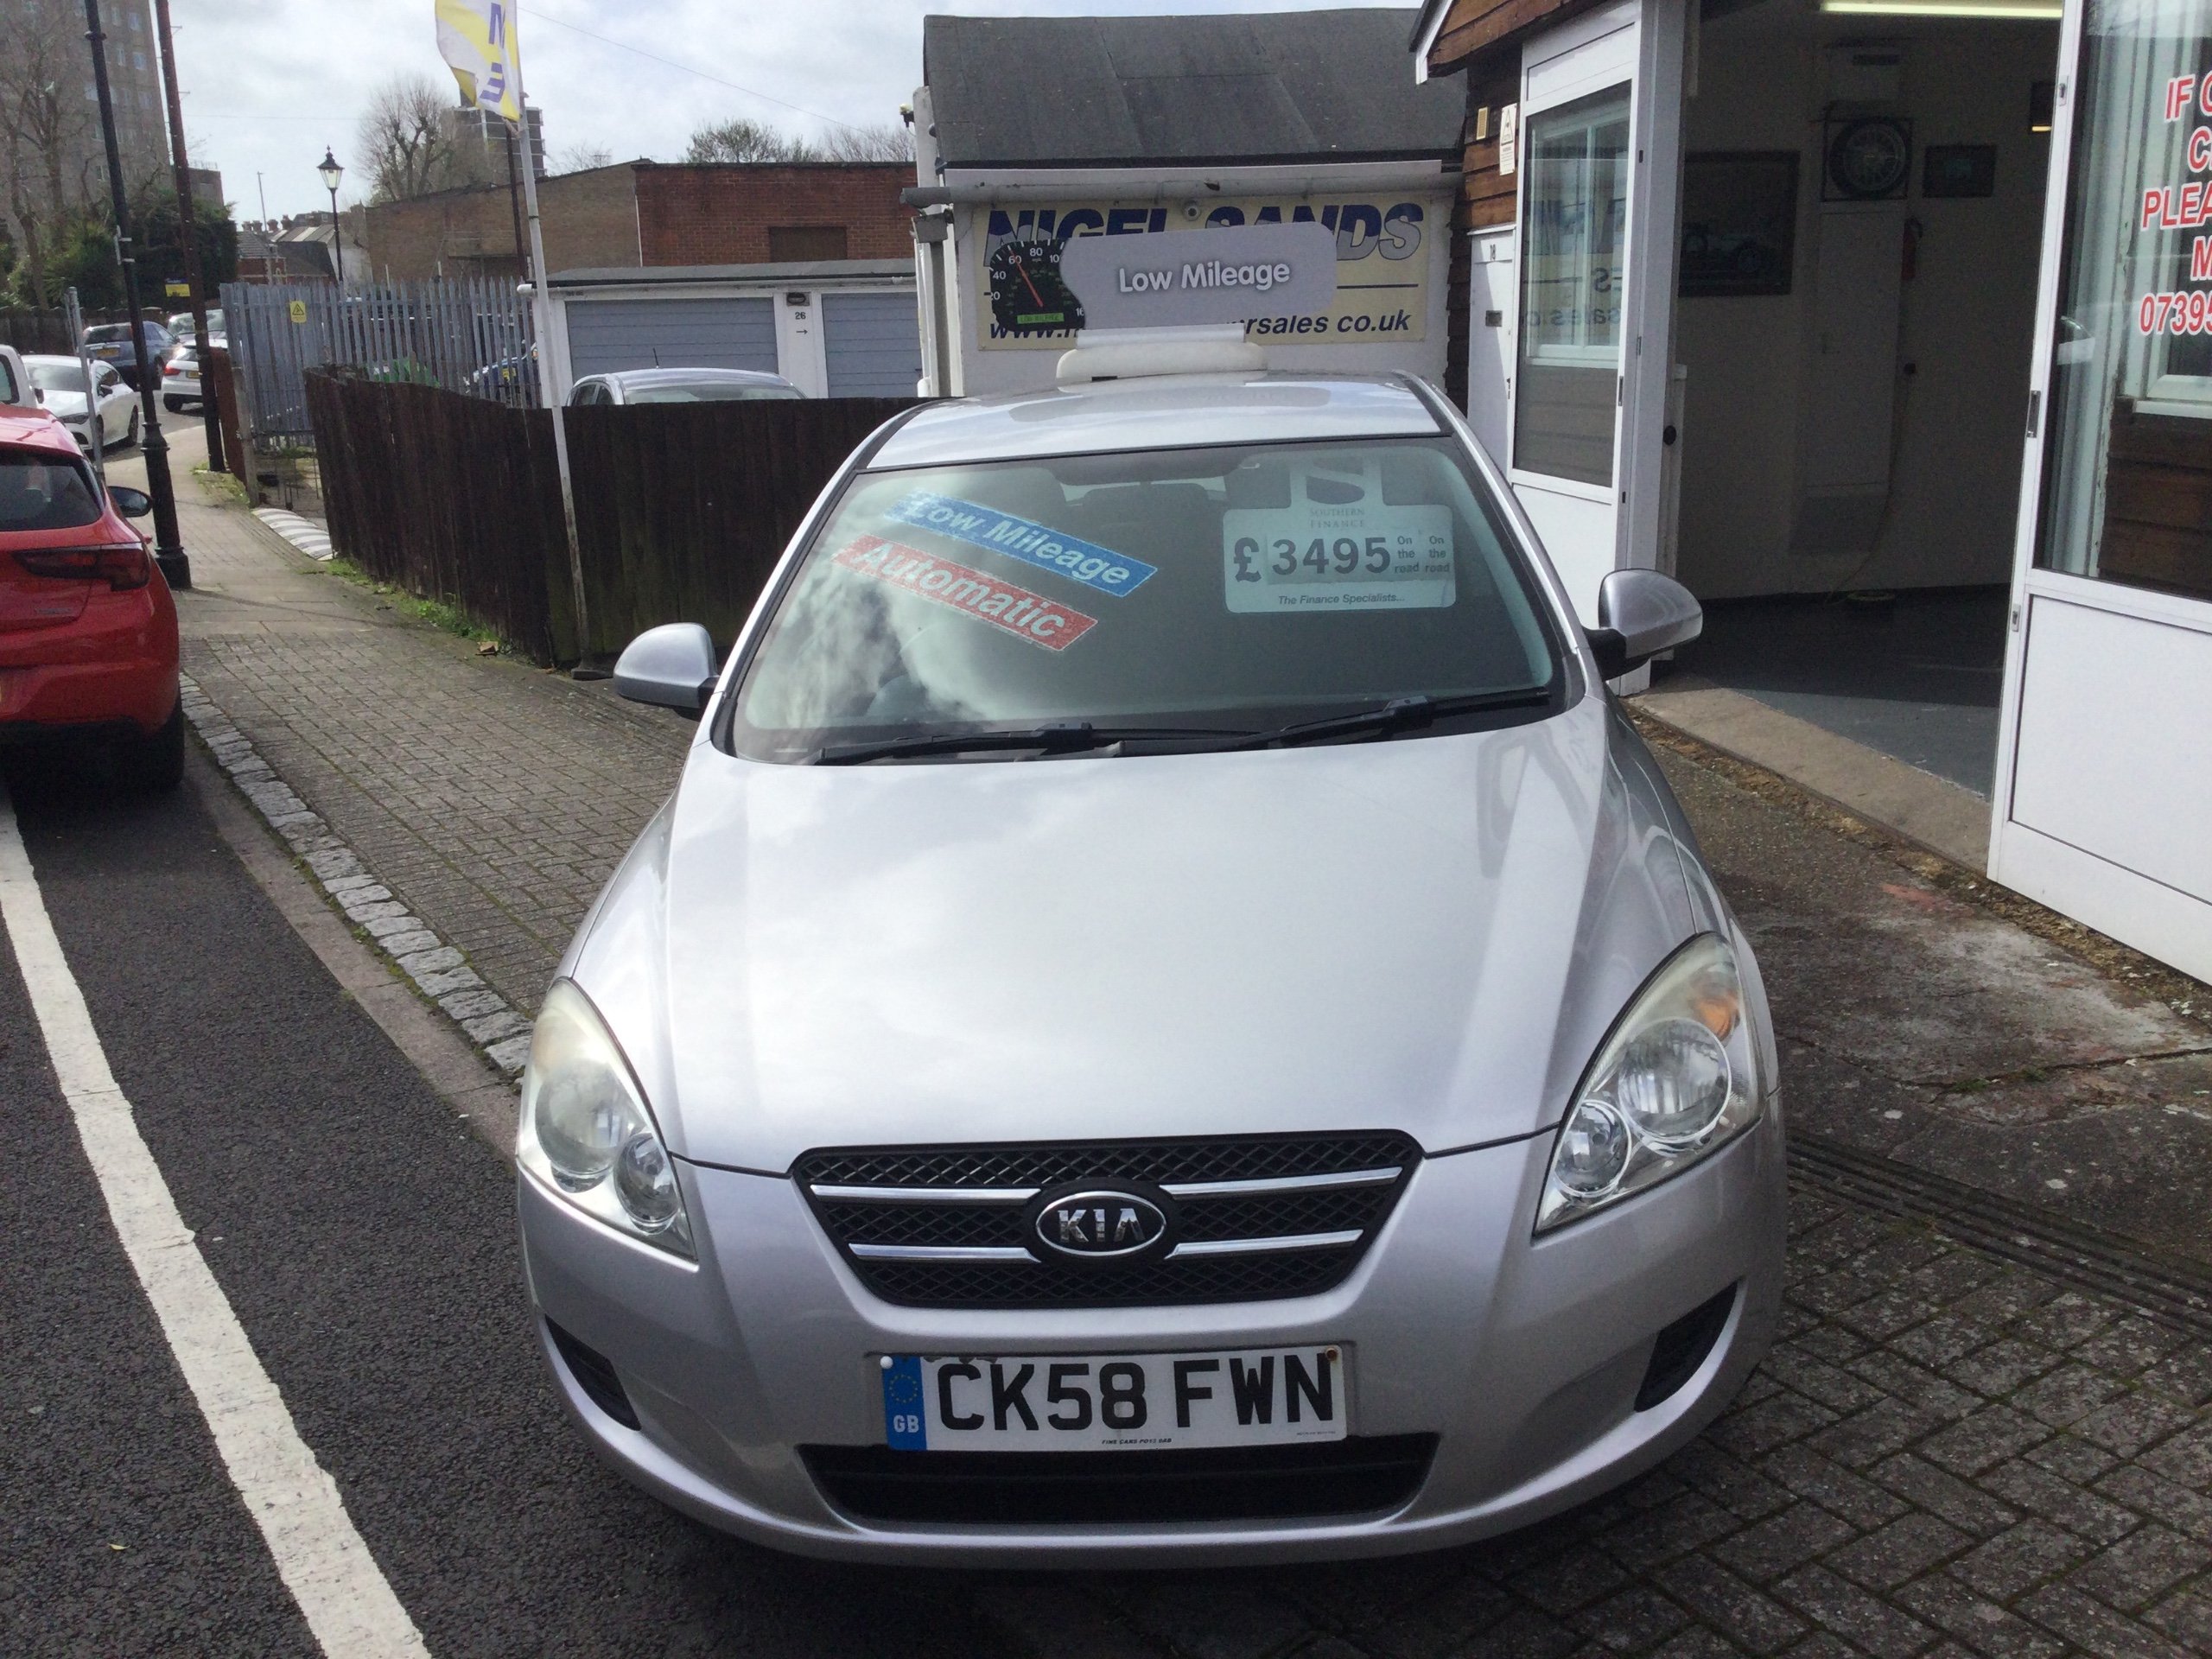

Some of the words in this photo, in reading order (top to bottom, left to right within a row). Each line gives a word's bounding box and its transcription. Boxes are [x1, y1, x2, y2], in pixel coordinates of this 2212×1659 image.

[2165, 76, 2195, 121] IF
[1029, 247, 1043, 257] 80
[1008, 255, 1022, 264] 60
[992, 270, 1007, 280] 40
[1119, 268, 1173, 293] Low
[1181, 261, 1290, 291] Mileage
[1397, 536, 1413, 545] On
[1429, 536, 1445, 544] On
[982, 519, 1130, 585] Mileage
[1397, 549, 1415, 559] the
[1428, 549, 1446, 558] the
[1395, 563, 1420, 574] road
[1425, 563, 1450, 573] road
[853, 543, 1066, 638] Automatic
[1279, 595, 1297, 605] The
[1300, 594, 1339, 604] Finance
[1057, 1207, 1146, 1243] KIA
[936, 1360, 1147, 1432] CK58
[1173, 1353, 1334, 1428] FWN
[893, 1414, 919, 1434] GB
